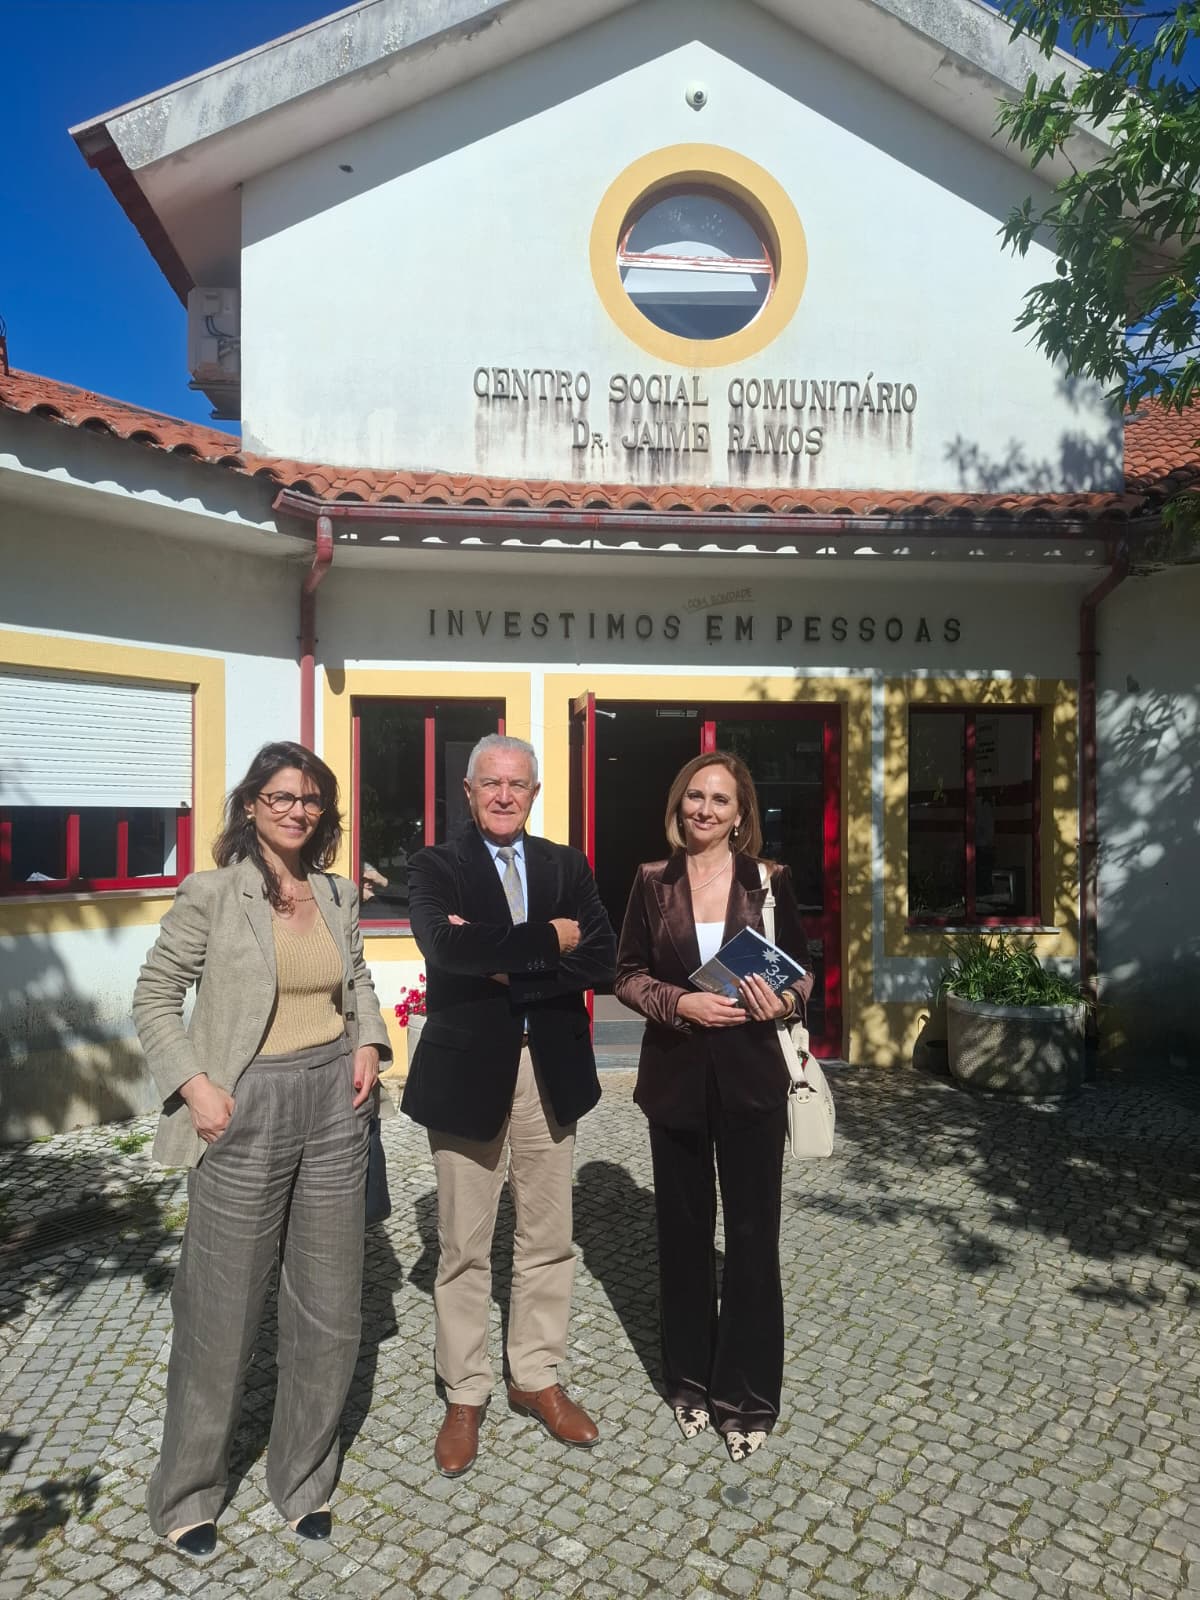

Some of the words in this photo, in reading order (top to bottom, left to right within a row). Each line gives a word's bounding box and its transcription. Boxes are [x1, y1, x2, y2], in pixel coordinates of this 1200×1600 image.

[473, 366, 590, 400] CENTRO
[608, 373, 709, 406] SOCIAL
[727, 371, 918, 412] COMUNITÁRIO
[622, 421, 709, 452] JAIME
[727, 423, 823, 455] RAMOS
[428, 608, 681, 640] INVESTIMOS
[705, 614, 755, 642] EM
[776, 616, 962, 643] PESSOAS
[765, 964, 789, 984] 34
